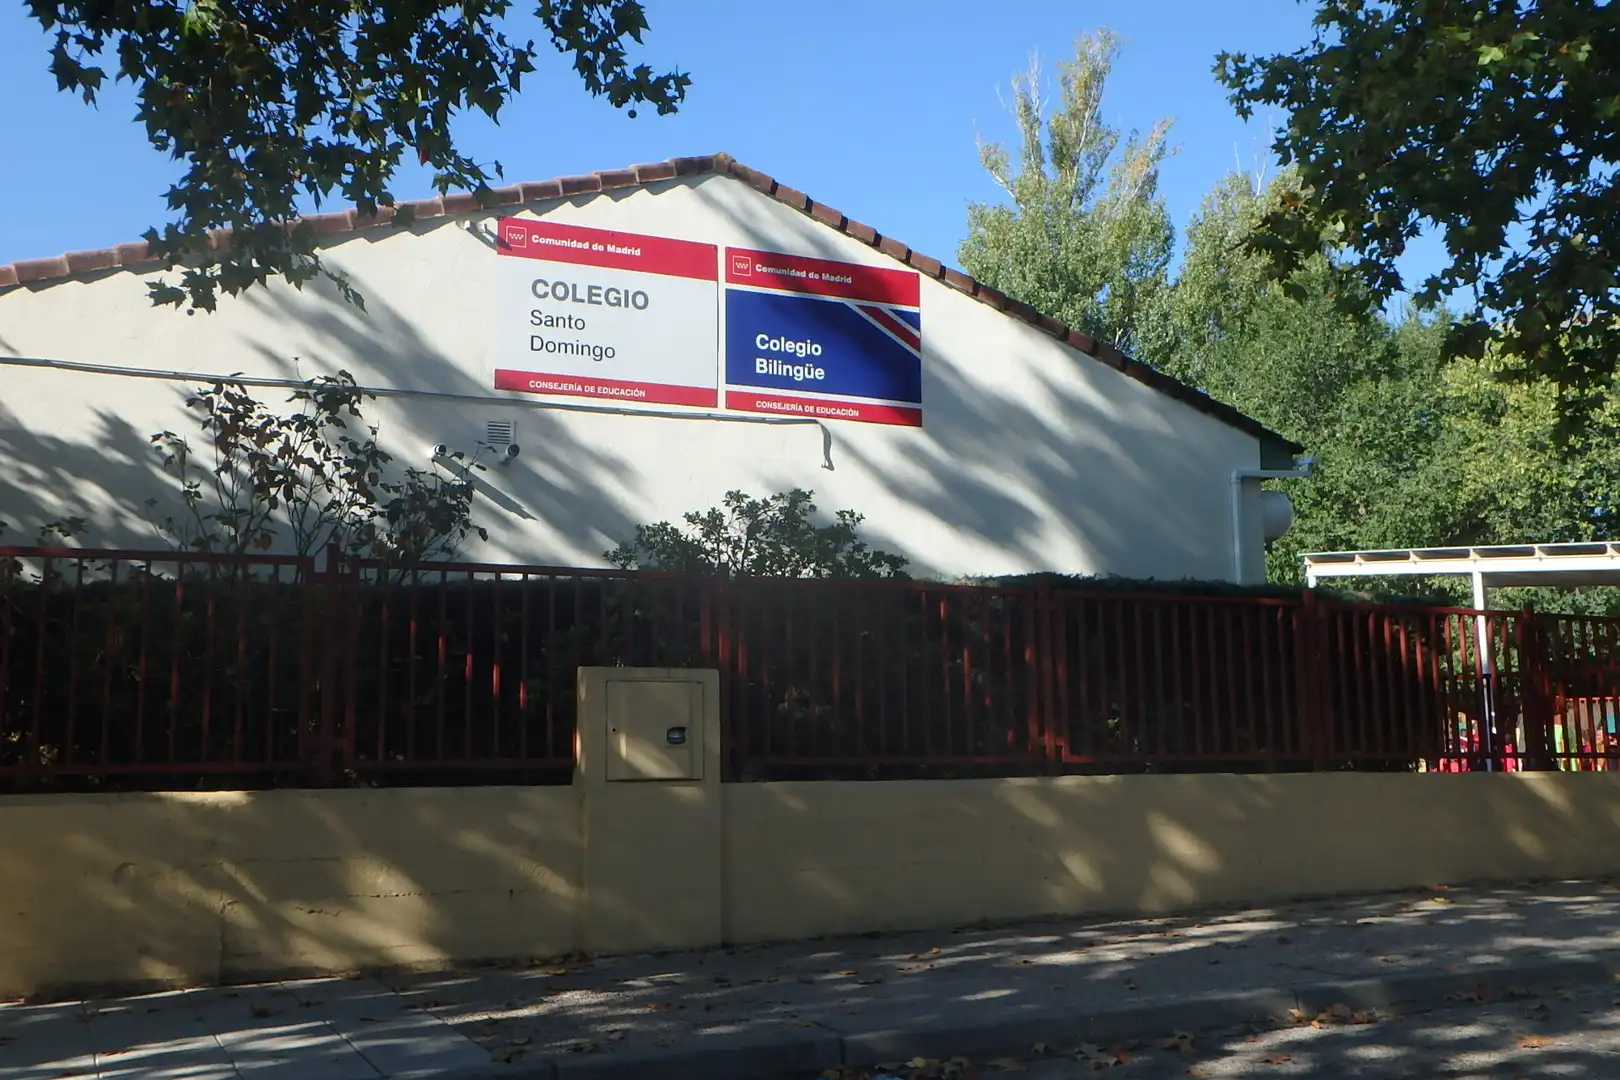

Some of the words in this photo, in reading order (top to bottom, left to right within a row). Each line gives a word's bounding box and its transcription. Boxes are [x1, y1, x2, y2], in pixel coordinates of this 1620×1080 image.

[531, 234, 590, 251] Comunidad
[591, 241, 605, 252] de
[606, 243, 642, 257] Madrid
[755, 263, 807, 279] Comunidad
[808, 270, 820, 280] de
[822, 272, 852, 284] Madrid
[531, 278, 649, 311] COLEGIO
[530, 309, 586, 331] Santo
[530, 335, 616, 361] Domingo
[755, 333, 823, 358] Colegio
[755, 357, 826, 382] Bilingüe
[529, 379, 583, 393] CONSEJERÍA
[584, 384, 596, 394] DE
[597, 385, 646, 398] EDUCACIÓN
[755, 400, 804, 412] CONSEJERÍA
[804, 404, 815, 413] DE
[816, 405, 860, 417] EDUCACIÓN
